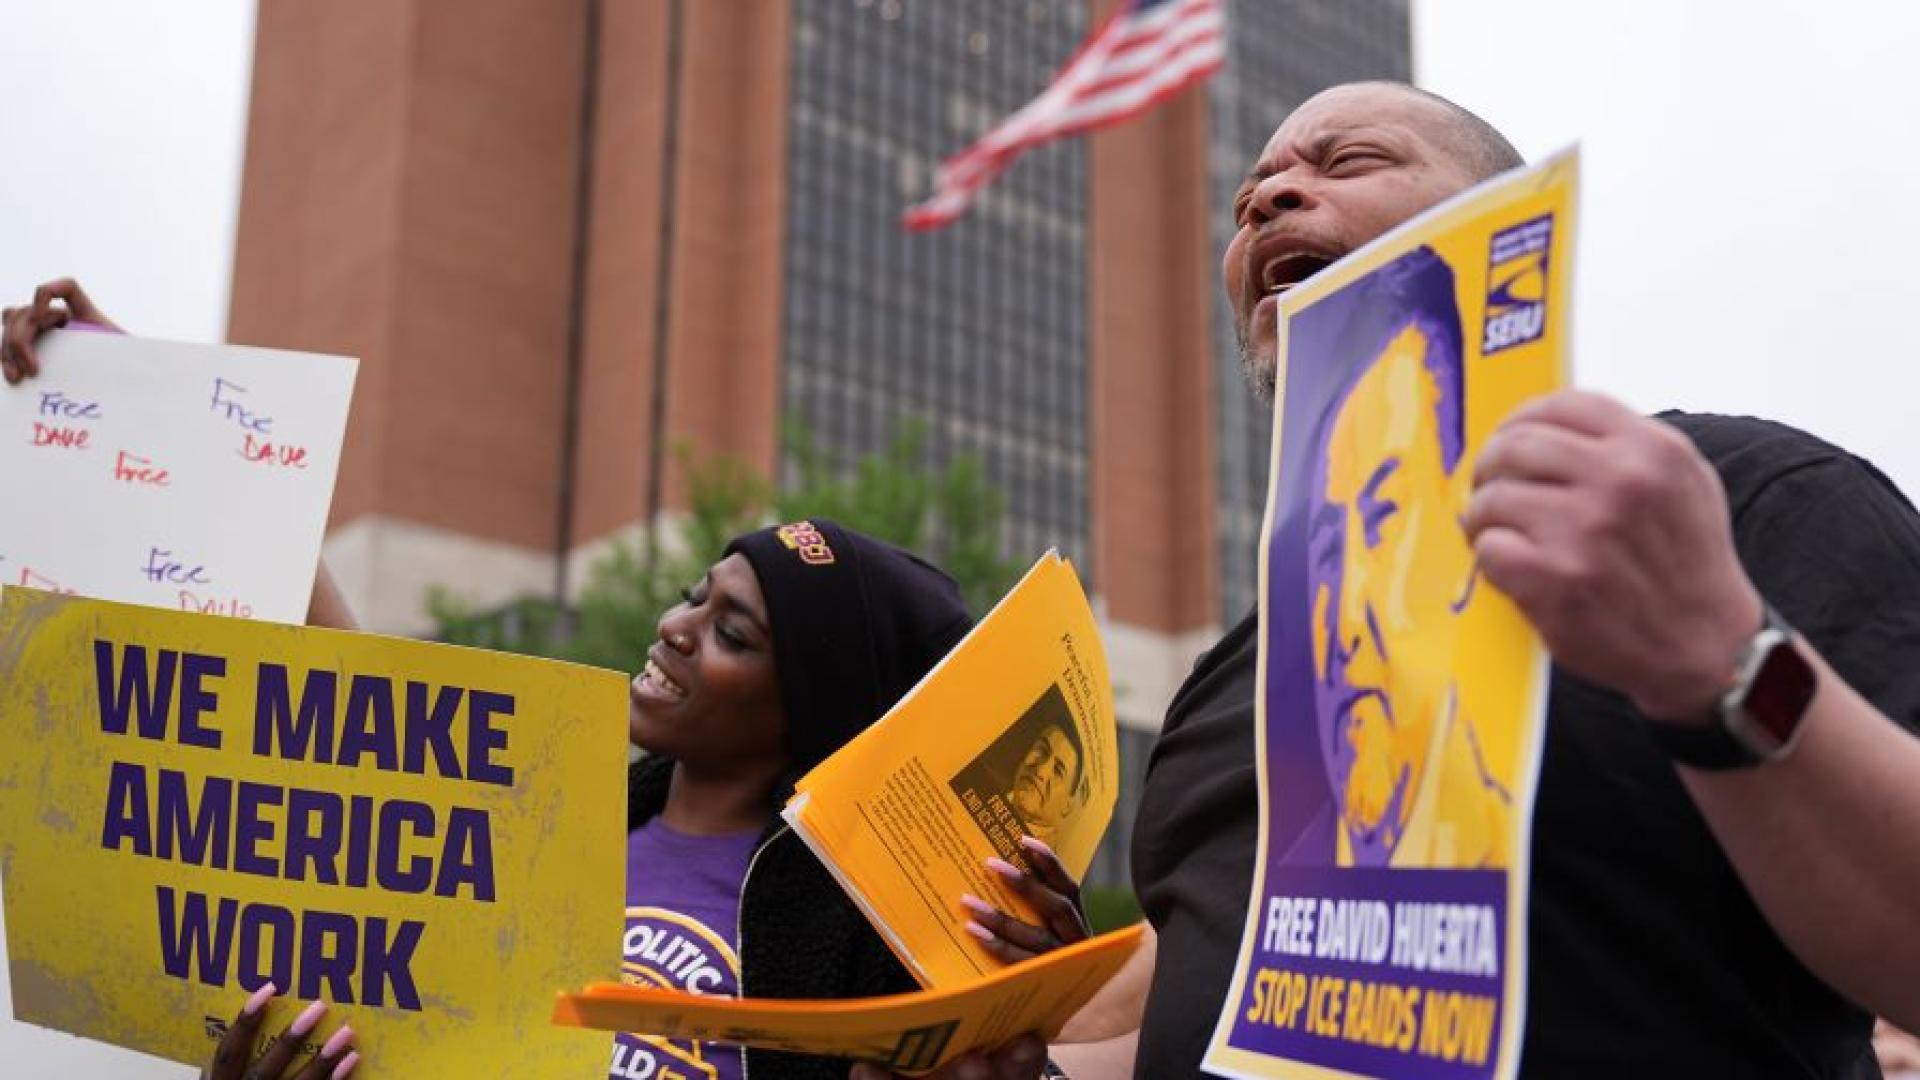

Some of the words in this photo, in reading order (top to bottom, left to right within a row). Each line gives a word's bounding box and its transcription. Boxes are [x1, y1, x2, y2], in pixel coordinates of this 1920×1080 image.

[39, 391, 102, 418] Free
[210, 377, 273, 433] Free
[114, 450, 171, 487] Free
[141, 547, 211, 583] Free
[94, 640, 227, 750] WE
[252, 661, 516, 787] MAKE
[102, 761, 497, 902] AMERICA
[156, 884, 427, 1012] WORK
[623, 925, 732, 1000] OLITIC
[1263, 896, 1318, 956] FREE
[1315, 898, 1391, 965] DAVID
[1391, 901, 1498, 977] HUERTA
[1246, 967, 1308, 1029] STOP
[1306, 974, 1346, 1038] ICE
[1343, 979, 1421, 1054] RAIDS
[1419, 990, 1498, 1066] NOW
